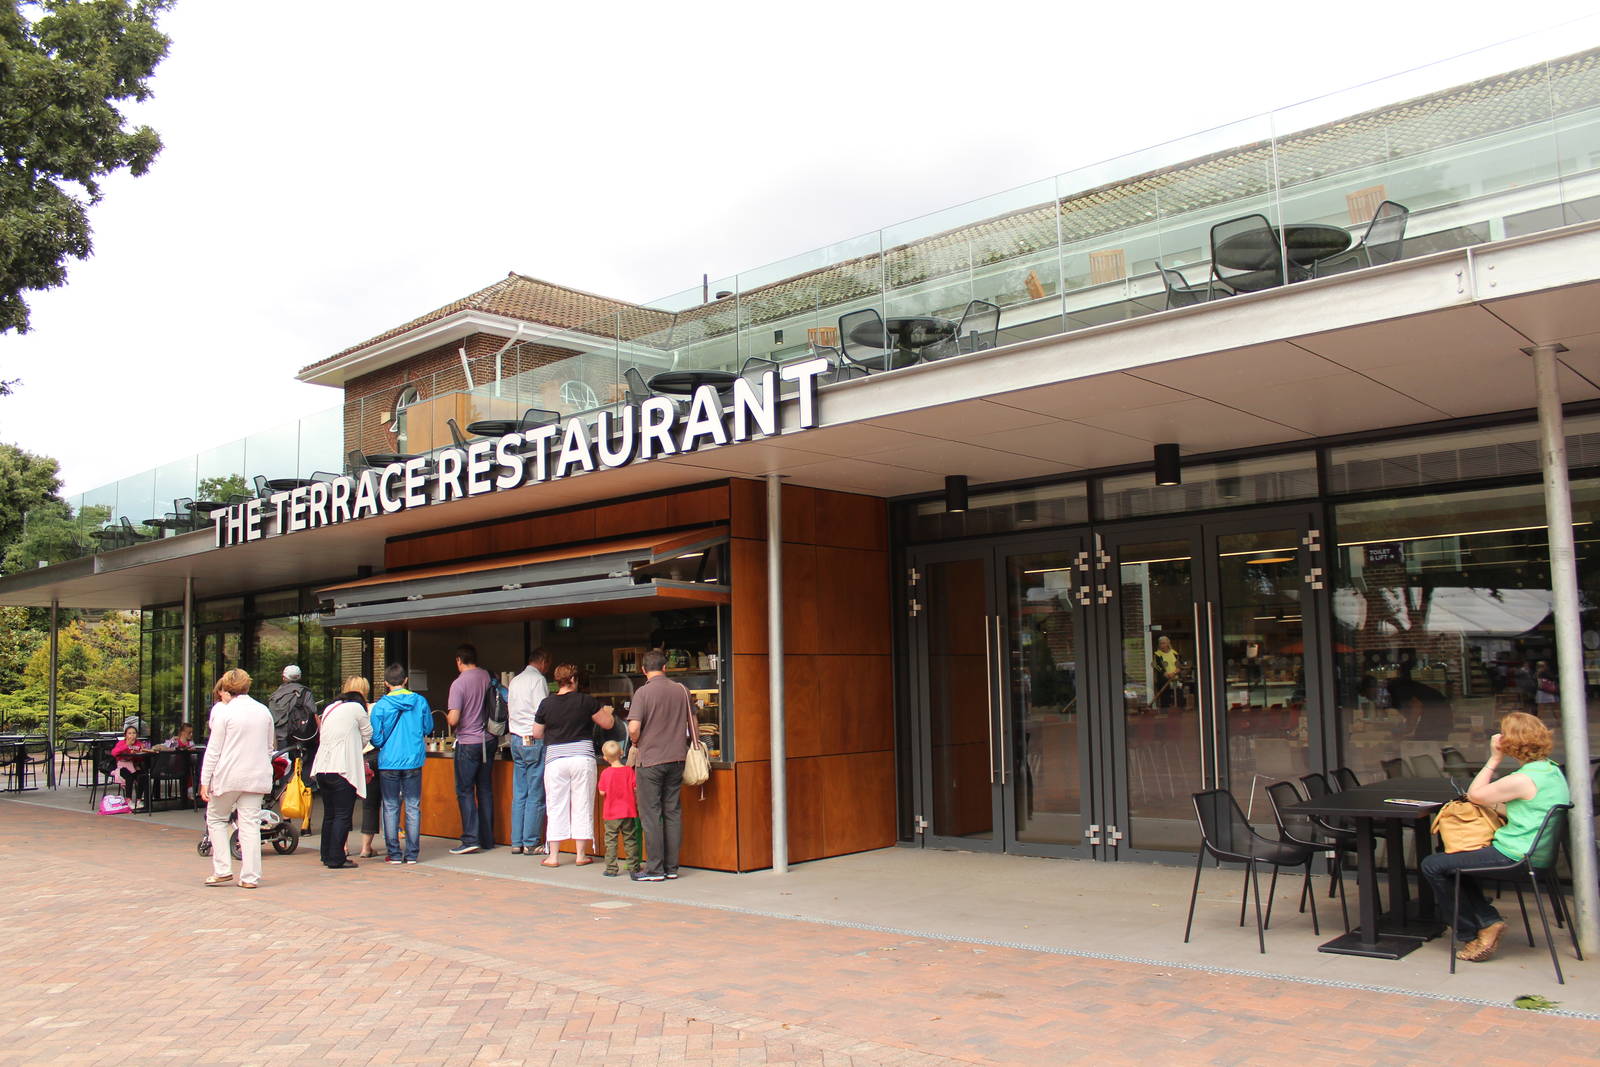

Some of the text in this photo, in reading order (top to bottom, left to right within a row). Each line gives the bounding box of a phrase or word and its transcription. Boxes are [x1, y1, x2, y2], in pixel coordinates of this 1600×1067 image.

[210, 358, 830, 548] THE TERRACE RESTAURANT
